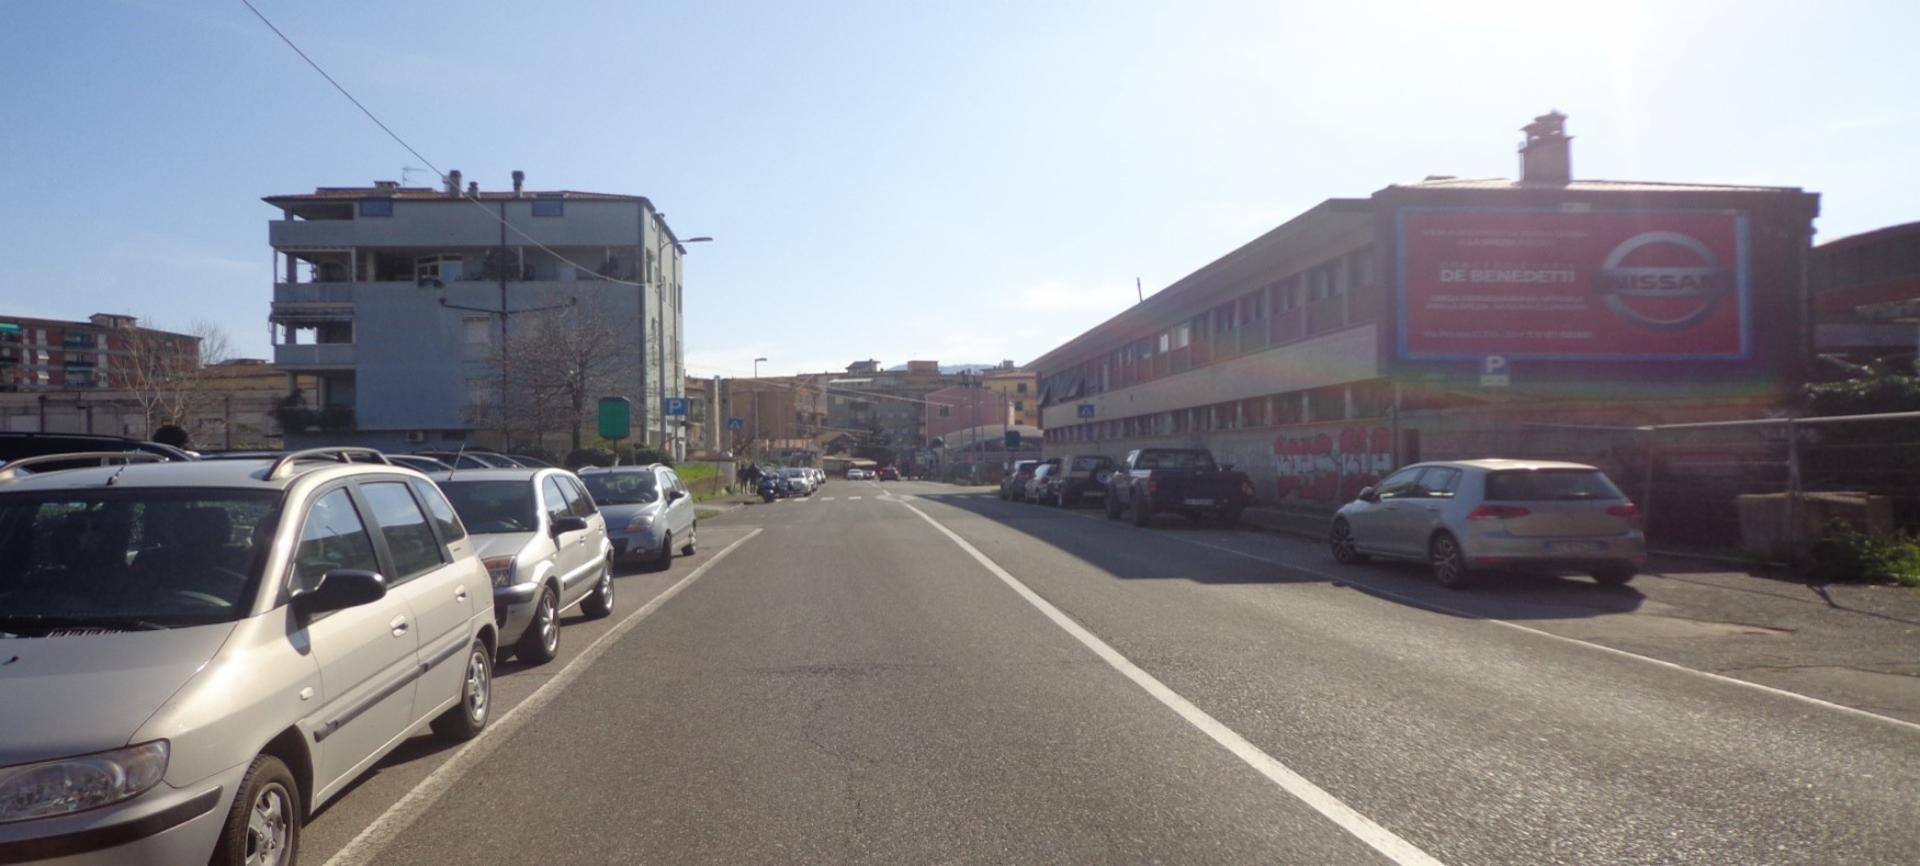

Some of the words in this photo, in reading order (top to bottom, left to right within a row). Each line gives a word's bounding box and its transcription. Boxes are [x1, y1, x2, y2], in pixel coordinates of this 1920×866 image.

[1440, 269, 1467, 282] DE
[1469, 269, 1576, 283] BENEDETTI
[1606, 274, 1720, 290] NISSAN
[1486, 355, 1505, 374] P
[668, 400, 682, 413] P
